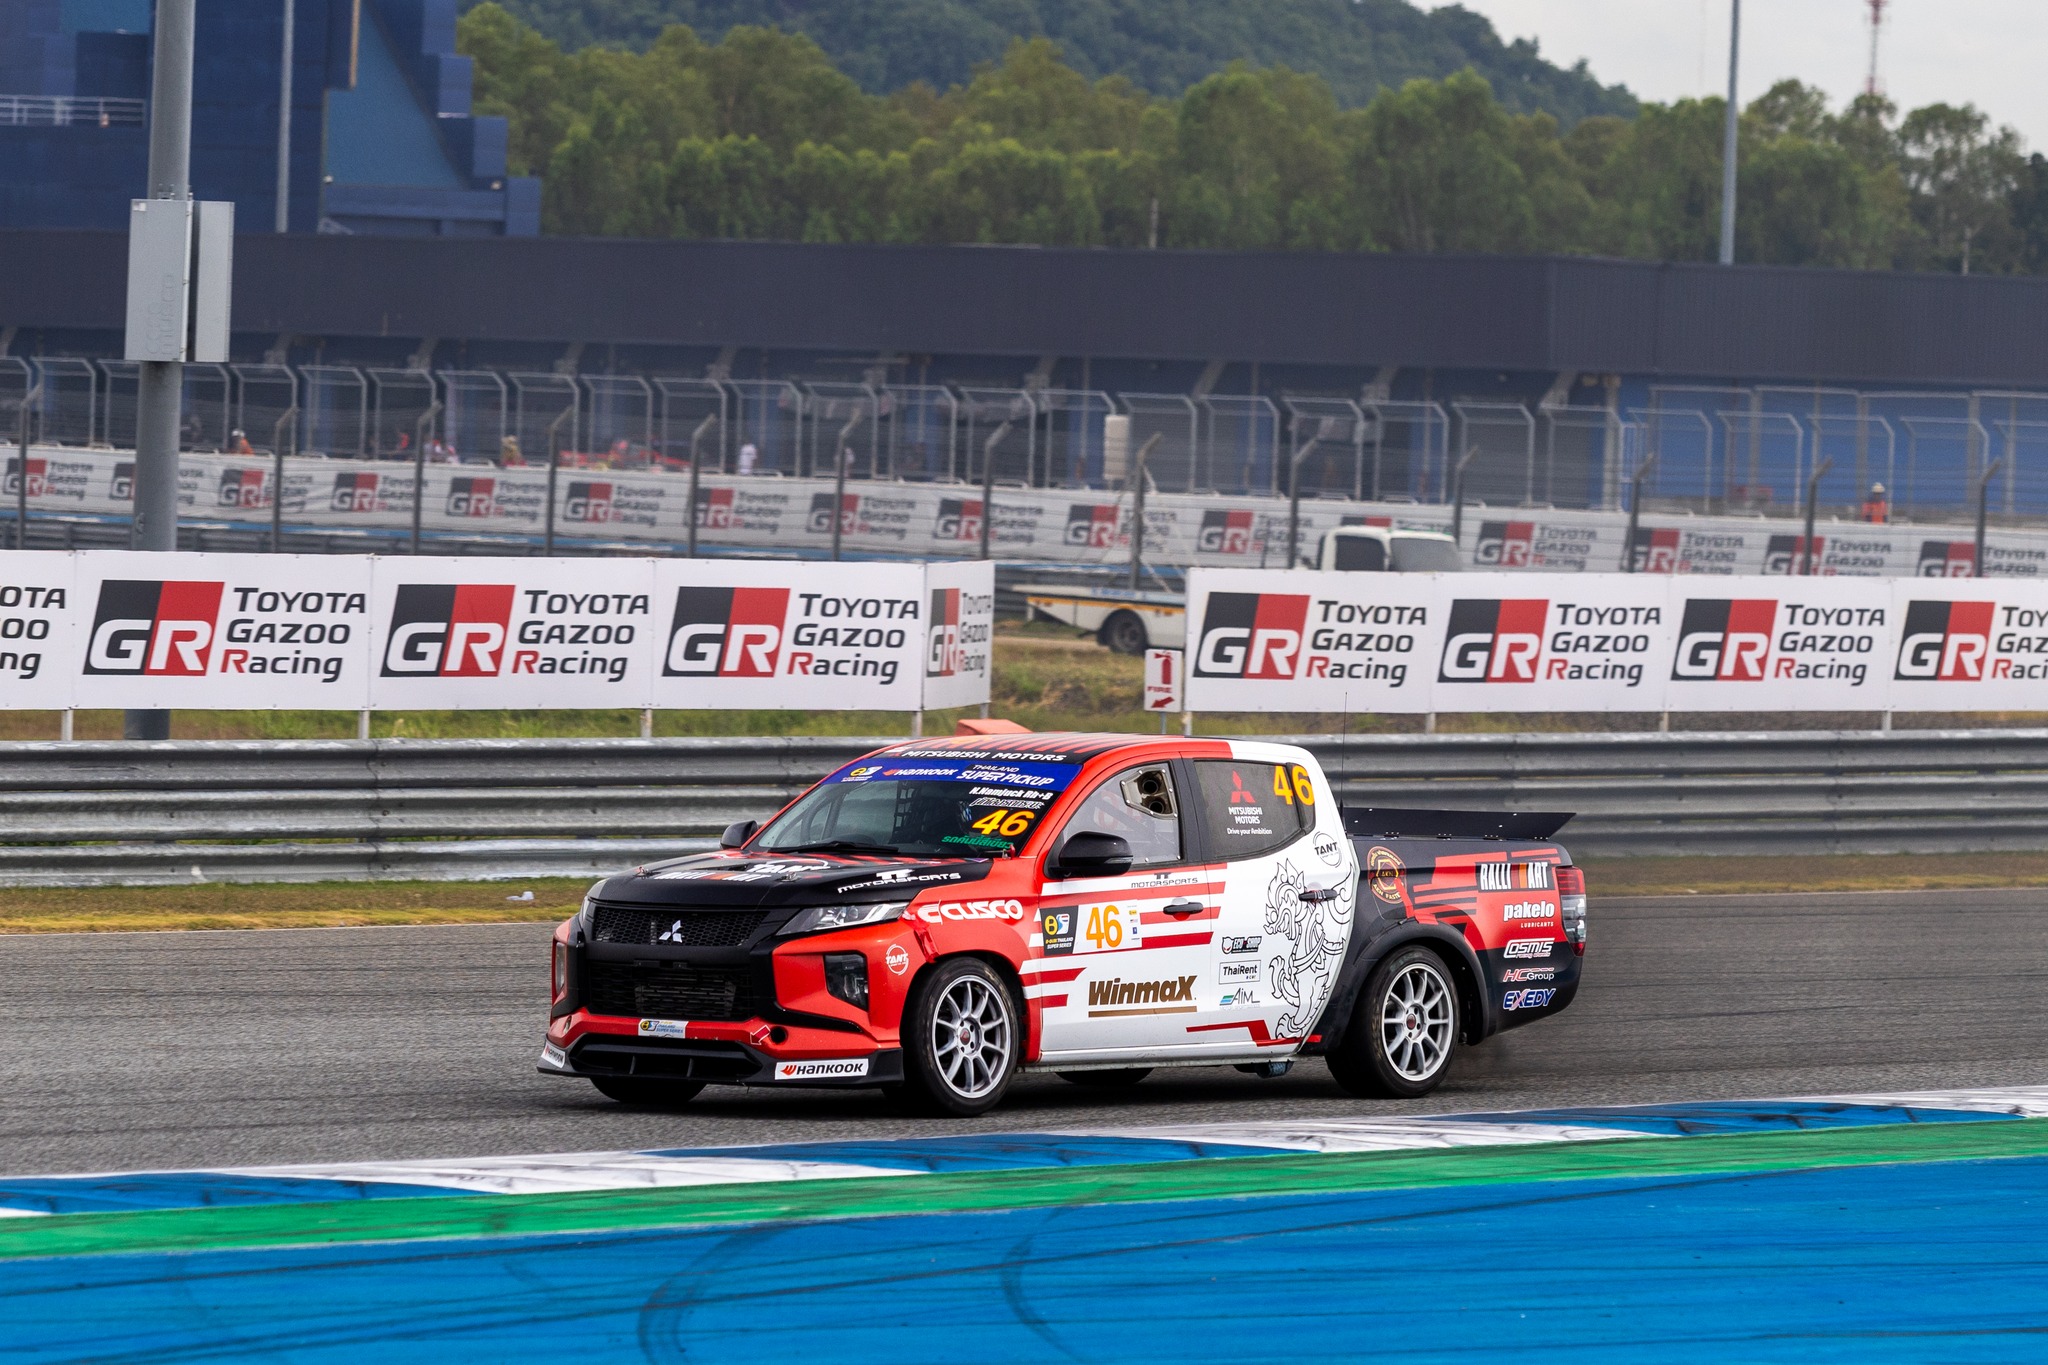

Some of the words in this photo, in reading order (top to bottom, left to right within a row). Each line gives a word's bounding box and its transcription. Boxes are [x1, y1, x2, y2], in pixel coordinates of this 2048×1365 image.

[0, 586, 65, 609] OTA
[233, 587, 366, 614] TOYOTA
[524, 590, 649, 615] TOYOTA
[799, 593, 919, 619] TOYOTA
[962, 592, 992, 615] TOYOTA
[1318, 600, 1427, 625] TOYOTA
[1556, 604, 1661, 625] TOYOTA
[1785, 604, 1885, 627] TOYOTA
[2002, 606, 2048, 627] TOY
[227, 618, 351, 644] GAZOO
[518, 621, 635, 645] GAZOO
[793, 623, 905, 648] GAZOO
[960, 621, 988, 644] GAZOO
[1311, 629, 1414, 653] GAZOO
[1551, 632, 1649, 653] GAZOO
[1779, 631, 1873, 653] GAZOO
[1996, 633, 2048, 653] GAZ
[89, 619, 212, 671] GR
[386, 622, 504, 672] GR
[668, 623, 780, 673] GR
[1198, 627, 1300, 676] GR
[1443, 633, 1540, 678] GR
[1676, 632, 1769, 677] GR
[1899, 632, 1987, 678] GR
[220, 649, 343, 683] Racing
[511, 650, 628, 683] Racing
[787, 652, 899, 685] Racing
[957, 649, 985, 678] Racing
[1306, 656, 1407, 688] Racing
[1546, 659, 1643, 688] Racing
[1774, 657, 1867, 687] Racing
[1992, 658, 2048, 679] Raci
[902, 751, 990, 759] MITSUBISHI
[992, 752, 1067, 762] MOTORS
[972, 764, 1020, 773] THAILAND
[956, 770, 1006, 782] SUPER
[1000, 773, 1055, 787] PICKUP
[1273, 765, 1315, 806] 46
[972, 809, 1036, 837] 46
[1228, 807, 1263, 815] MITSUBISHI
[1234, 815, 1261, 824] MOTORS
[1314, 841, 1338, 856] TANT
[837, 872, 962, 894] MOTORSPORTS
[1131, 877, 1198, 888] MOTORSPORTS
[1503, 900, 1555, 922] pakelo
[1086, 904, 1123, 949] 46
[1223, 964, 1258, 976] ThaiRent
[1503, 988, 1557, 1011] EXEDY
